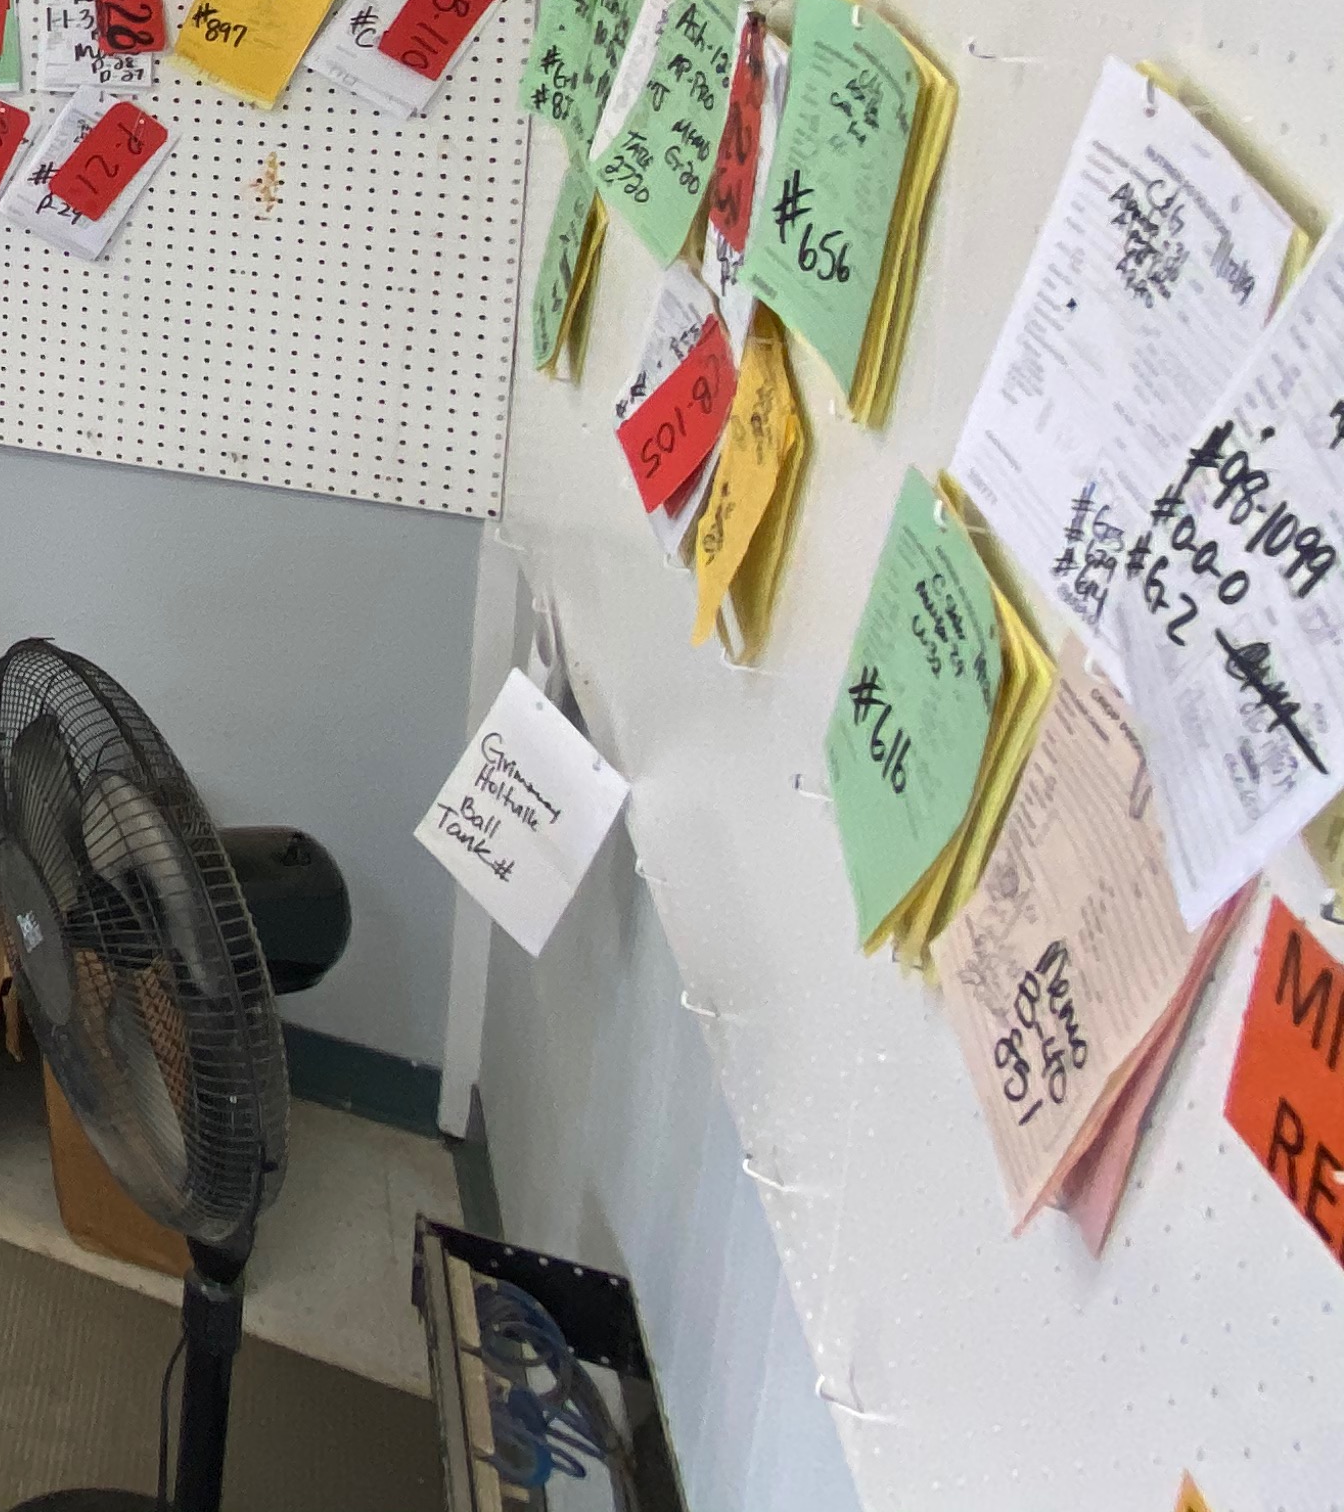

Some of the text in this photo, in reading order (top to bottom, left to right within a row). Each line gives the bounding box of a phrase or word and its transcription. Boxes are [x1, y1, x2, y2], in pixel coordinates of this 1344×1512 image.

[192, 2, 249, 48] #897
[772, 169, 853, 284] #656
[848, 665, 912, 794] #616
